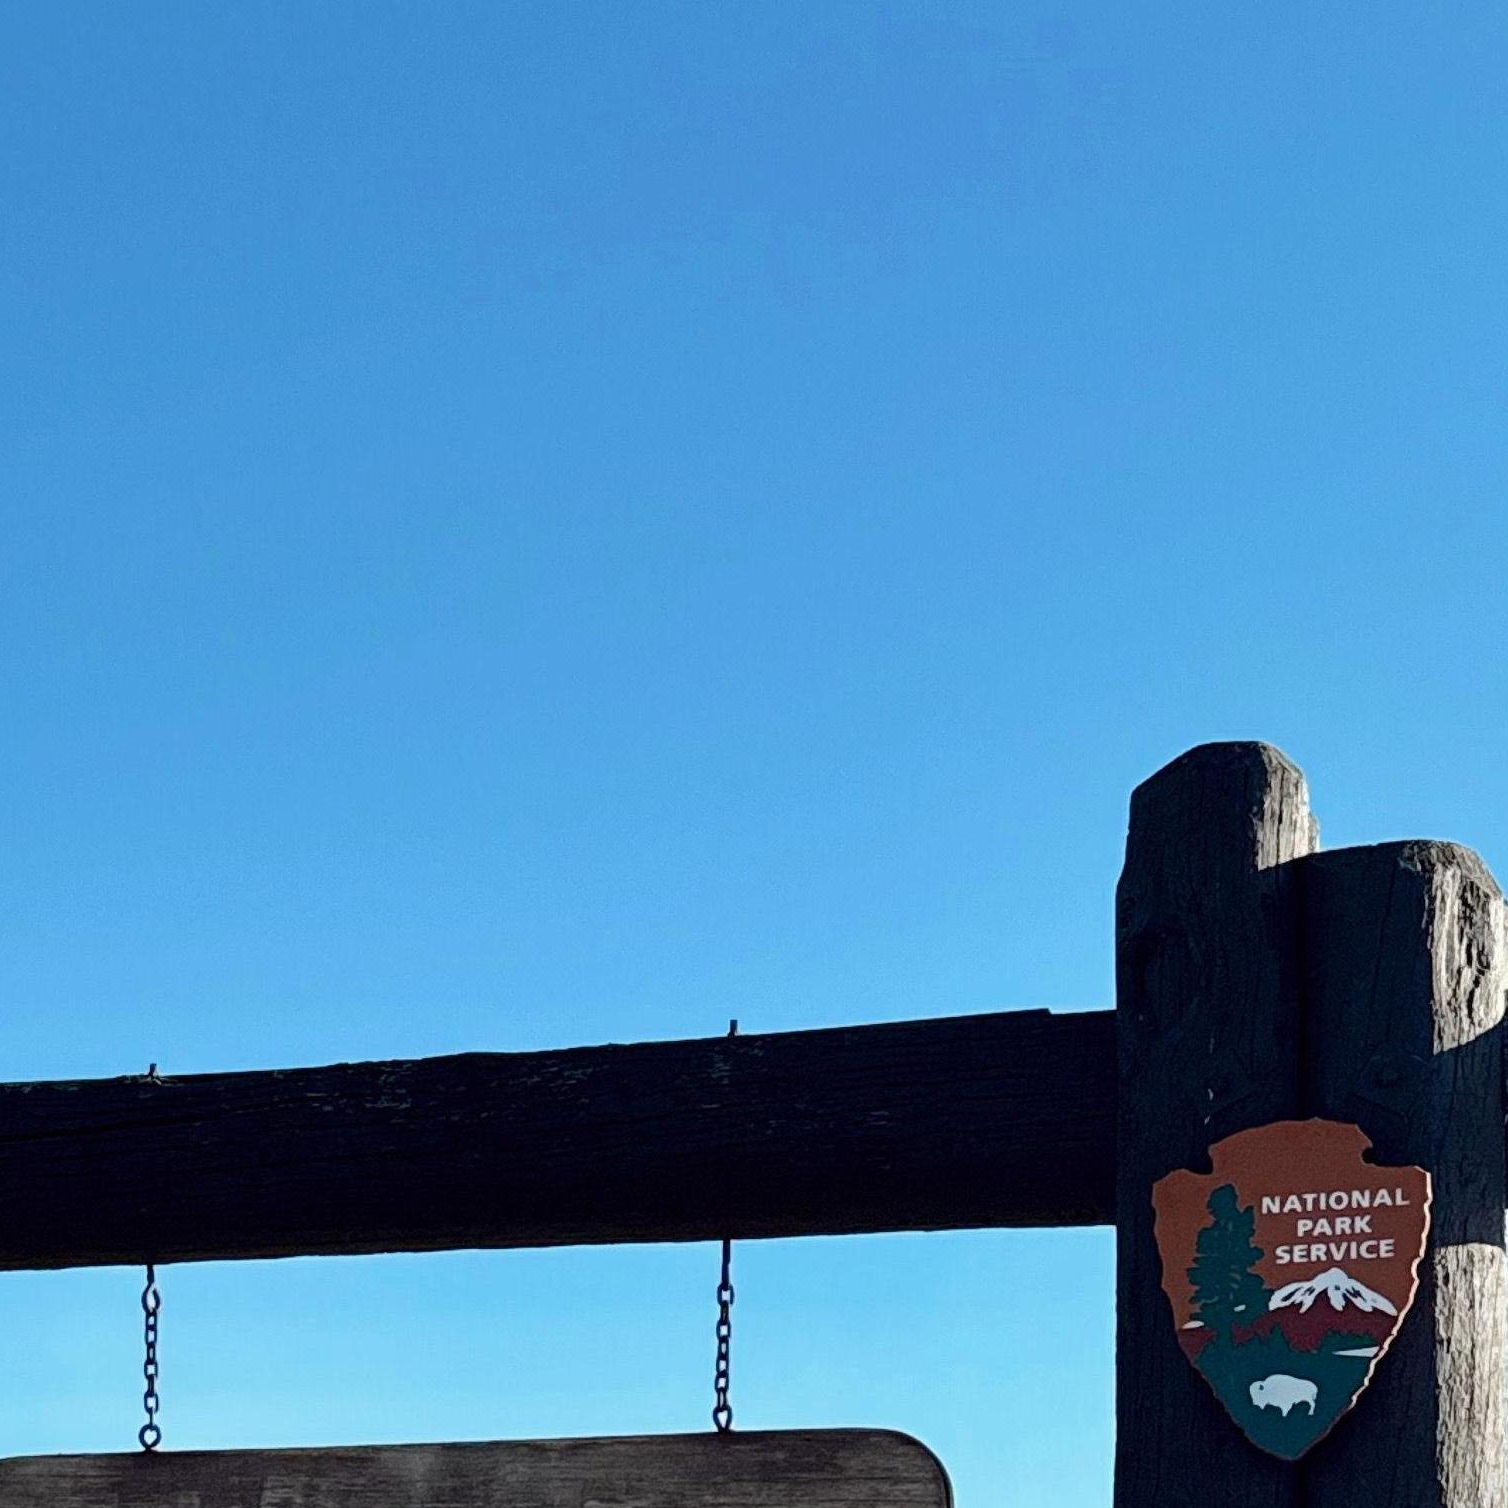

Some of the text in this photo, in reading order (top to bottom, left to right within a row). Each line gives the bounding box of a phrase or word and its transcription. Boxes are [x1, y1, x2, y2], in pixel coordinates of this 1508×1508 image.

[1261, 1187, 1411, 1214] NATIONAL
[1296, 1215, 1373, 1238] PARK
[1275, 1238, 1396, 1265] SERVICE
